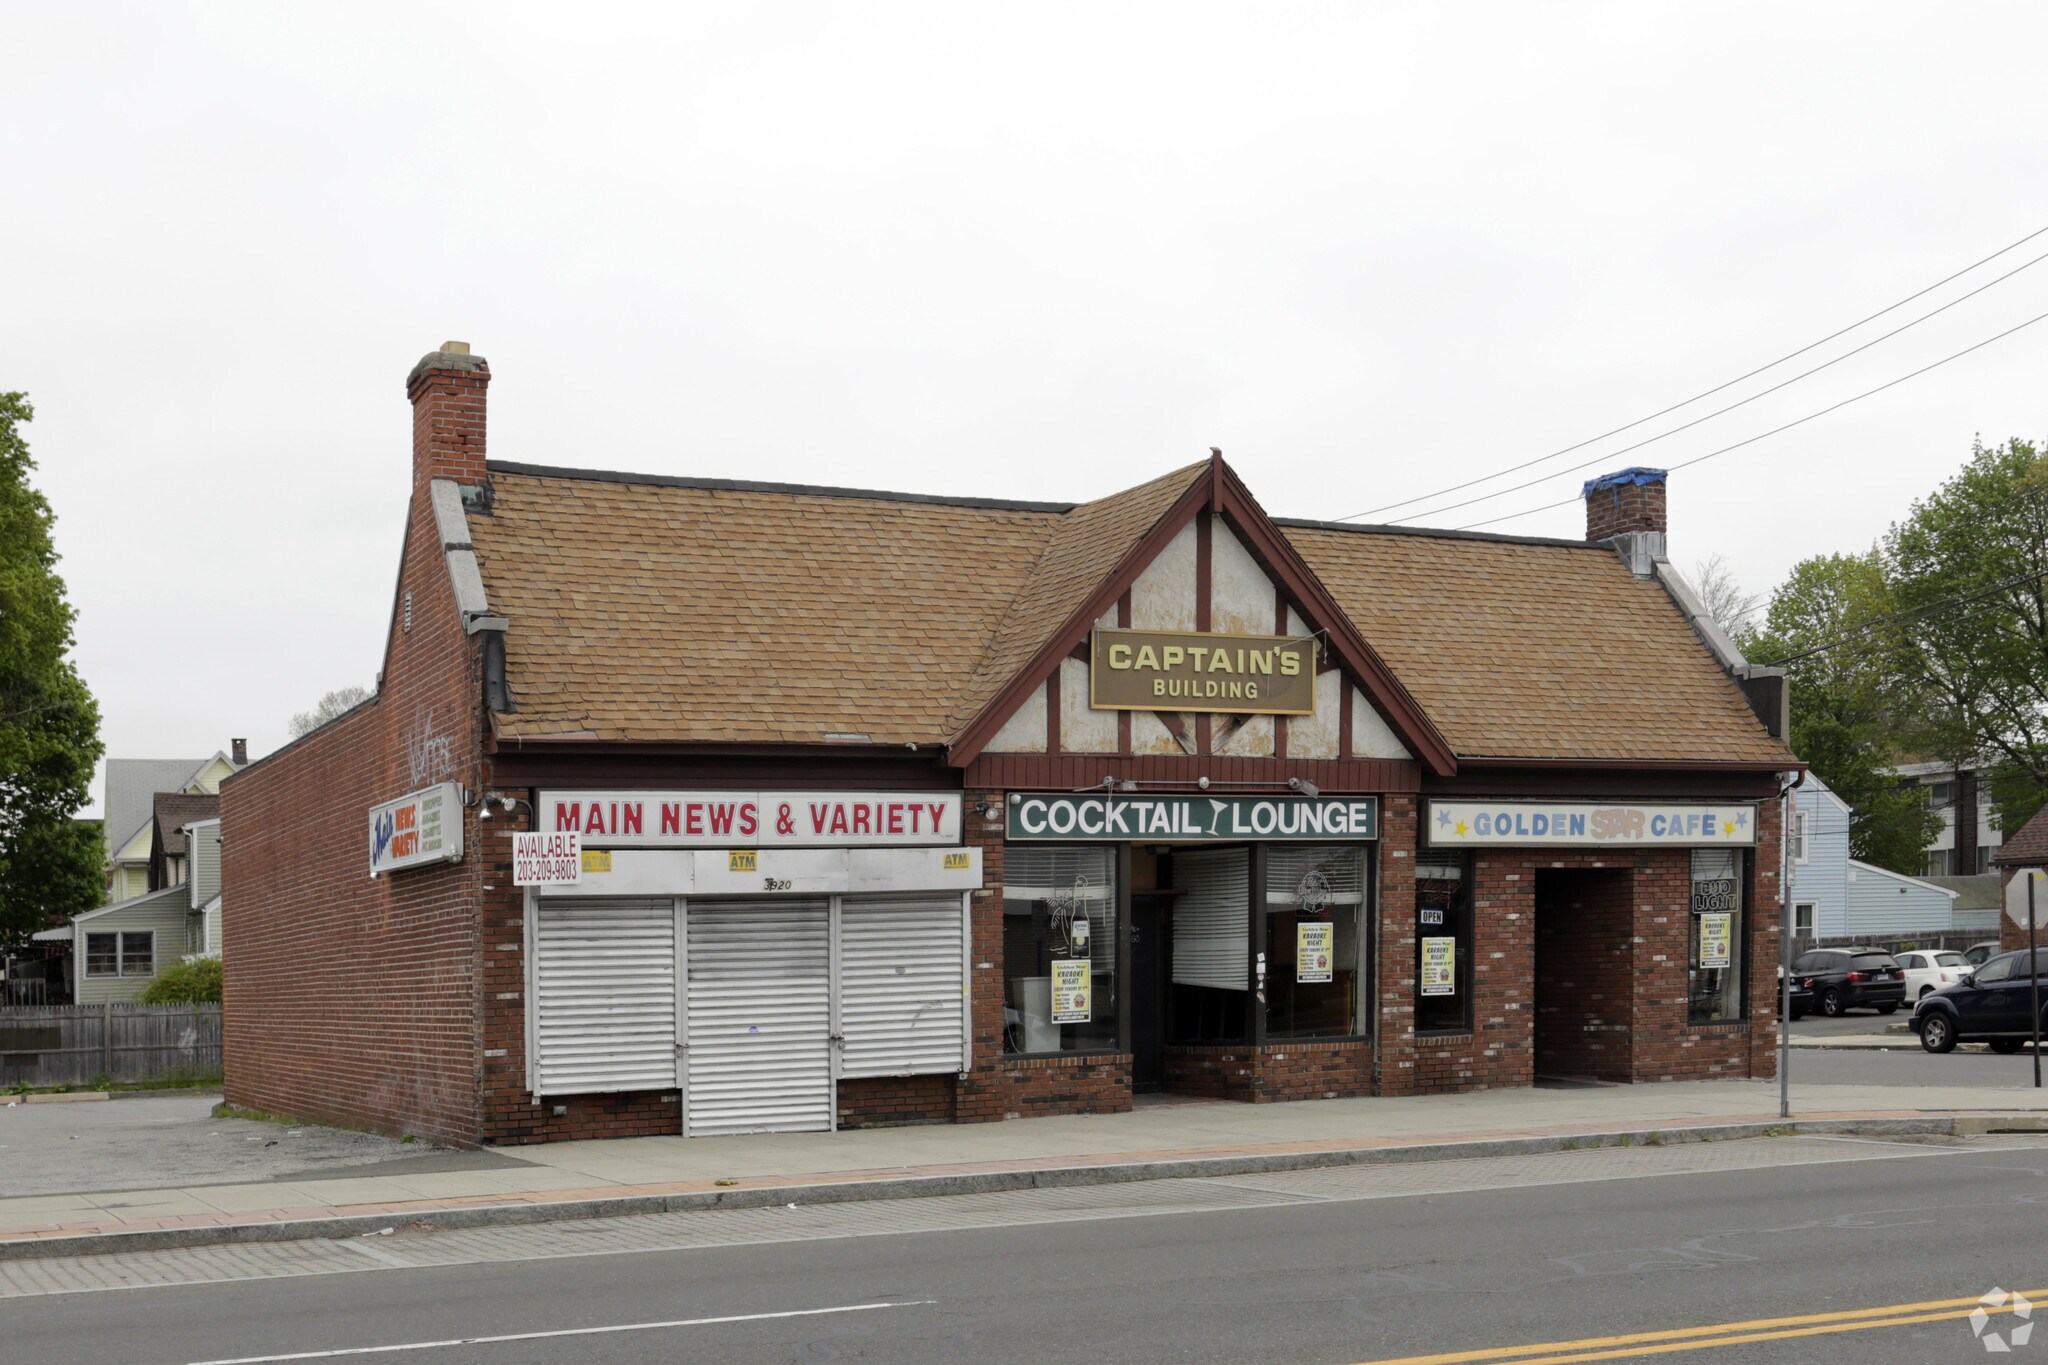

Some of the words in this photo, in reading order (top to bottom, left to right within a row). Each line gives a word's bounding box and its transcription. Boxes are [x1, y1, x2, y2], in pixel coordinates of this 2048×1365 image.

[1108, 644, 1300, 676] CAPTAIN'S
[1153, 678, 1258, 699] BUILDING
[555, 801, 644, 836] MAIN
[659, 801, 759, 837] NEWS
[775, 801, 797, 837] &
[808, 801, 948, 836] VARIETY
[1020, 799, 1202, 834] COCKTAIL
[1232, 801, 1367, 834] LOUNGE
[1474, 812, 1586, 836] GOLDEN
[1590, 808, 1646, 840] STAR
[1651, 814, 1717, 836] CAFE
[373, 810, 394, 867] Main
[396, 803, 416, 832] NEWS
[392, 830, 419, 859] VARIETY
[517, 835, 577, 859] AVAILABLE
[517, 859, 577, 881] 203-209-9803
[730, 855, 756, 868] ATM
[944, 853, 968, 865] ATM
[1701, 880, 1731, 896] BUD
[1694, 894, 1737, 911] LIGHT
[1423, 911, 1442, 923] OPEN
[1057, 970, 1084, 978] KARAOKE
